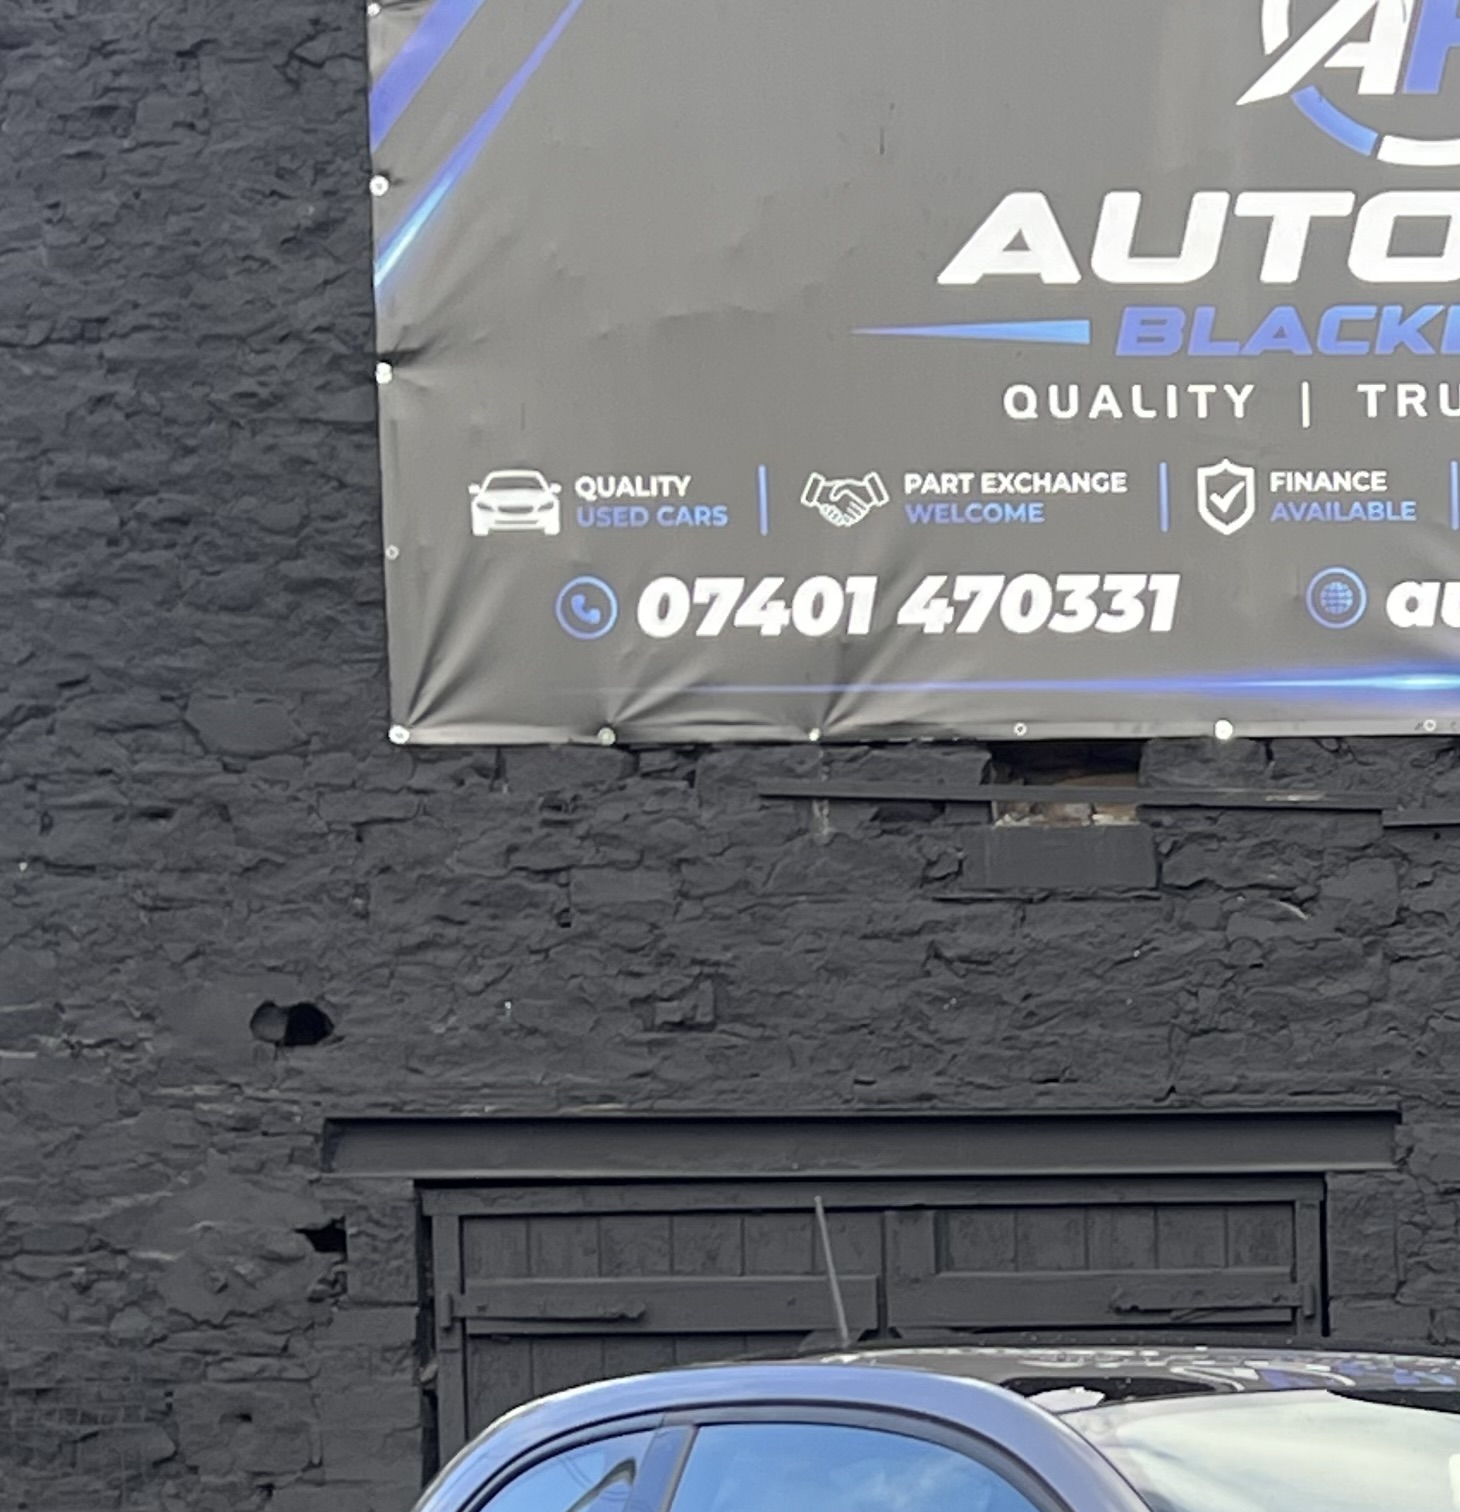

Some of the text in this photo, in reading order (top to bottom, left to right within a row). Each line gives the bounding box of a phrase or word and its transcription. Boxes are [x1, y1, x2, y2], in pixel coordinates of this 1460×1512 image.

[1004, 385, 1254, 419] QUALITY
[575, 476, 691, 500] QUALITY
[905, 472, 1127, 494] PART EXCHANGE
[1271, 471, 1387, 492] FINANCE
[578, 506, 728, 526] USED CARS
[906, 503, 1044, 522] WELCOME
[1272, 501, 1416, 520] AVAILABLE
[638, 574, 1180, 637] 07401 470331
